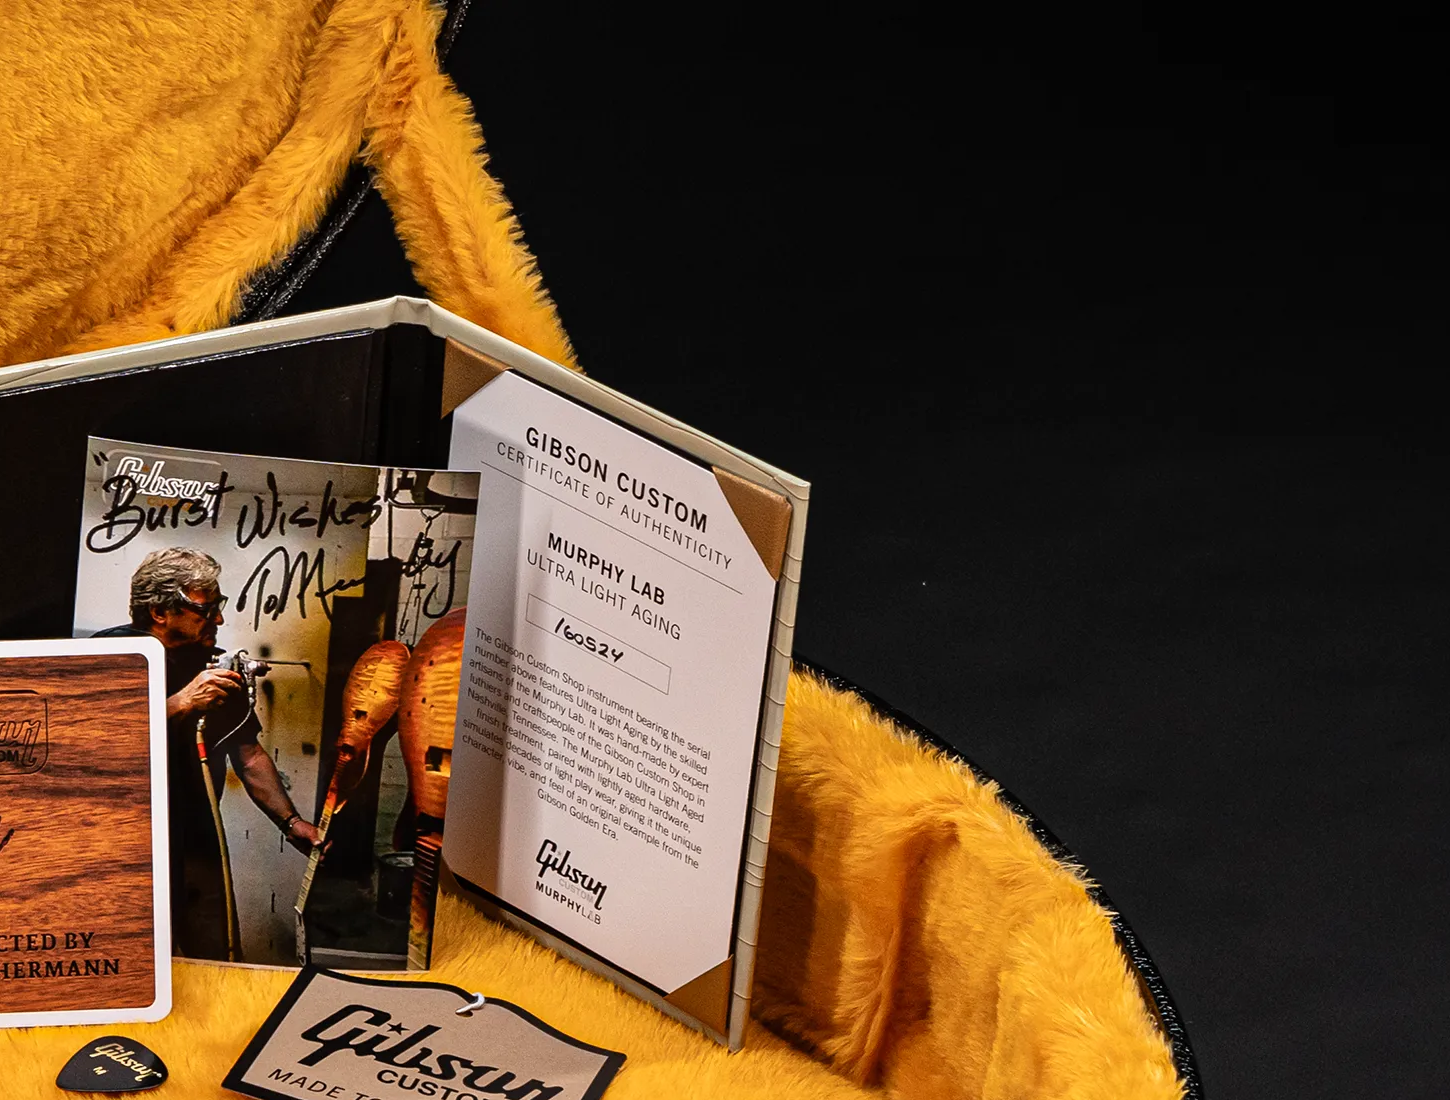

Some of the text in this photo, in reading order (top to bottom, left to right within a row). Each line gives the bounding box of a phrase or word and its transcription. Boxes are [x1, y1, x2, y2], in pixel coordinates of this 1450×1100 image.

[496, 441, 733, 570] CERTIFICATE OF AUTHENTICITY
[525, 426, 708, 533] GIBSON CUSTOM
[526, 549, 682, 641] ULTRA LIGHT AGING
[548, 532, 666, 606] MURPHY LAB
[553, 617, 625, 664] 160524
[469, 658, 709, 793] artisans of the Murphy Lab. It was hand-made by expert
[469, 672, 706, 808] luthiers and craftspeople of the Gibson Custom Shop in
[474, 645, 708, 776] number above features Ultra Light Aging by the skilled
[475, 627, 711, 761] The Gibson Custom Shop instrument bearing the serial
[476, 707, 500, 728] finish
[548, 748, 576, 768] paired
[577, 763, 595, 779] with
[597, 772, 623, 796] lightly
[624, 789, 647, 808] aged
[648, 801, 691, 834] hardware,
[512, 709, 558, 743] Tennessee.
[562, 736, 579, 754] The
[580, 747, 615, 774] Murphy
[616, 766, 633, 784] Lab
[634, 777, 656, 797] Ultra
[658, 790, 680, 810] Light
[681, 804, 705, 823] Aged
[537, 788, 619, 841] Gibson Golden Era.
[535, 838, 608, 911] Gibson
[558, 878, 594, 903] CUSTOM
[63, 931, 96, 951] BY
[89, 1042, 156, 1083] Gibson
[267, 1067, 343, 1097] MADE
